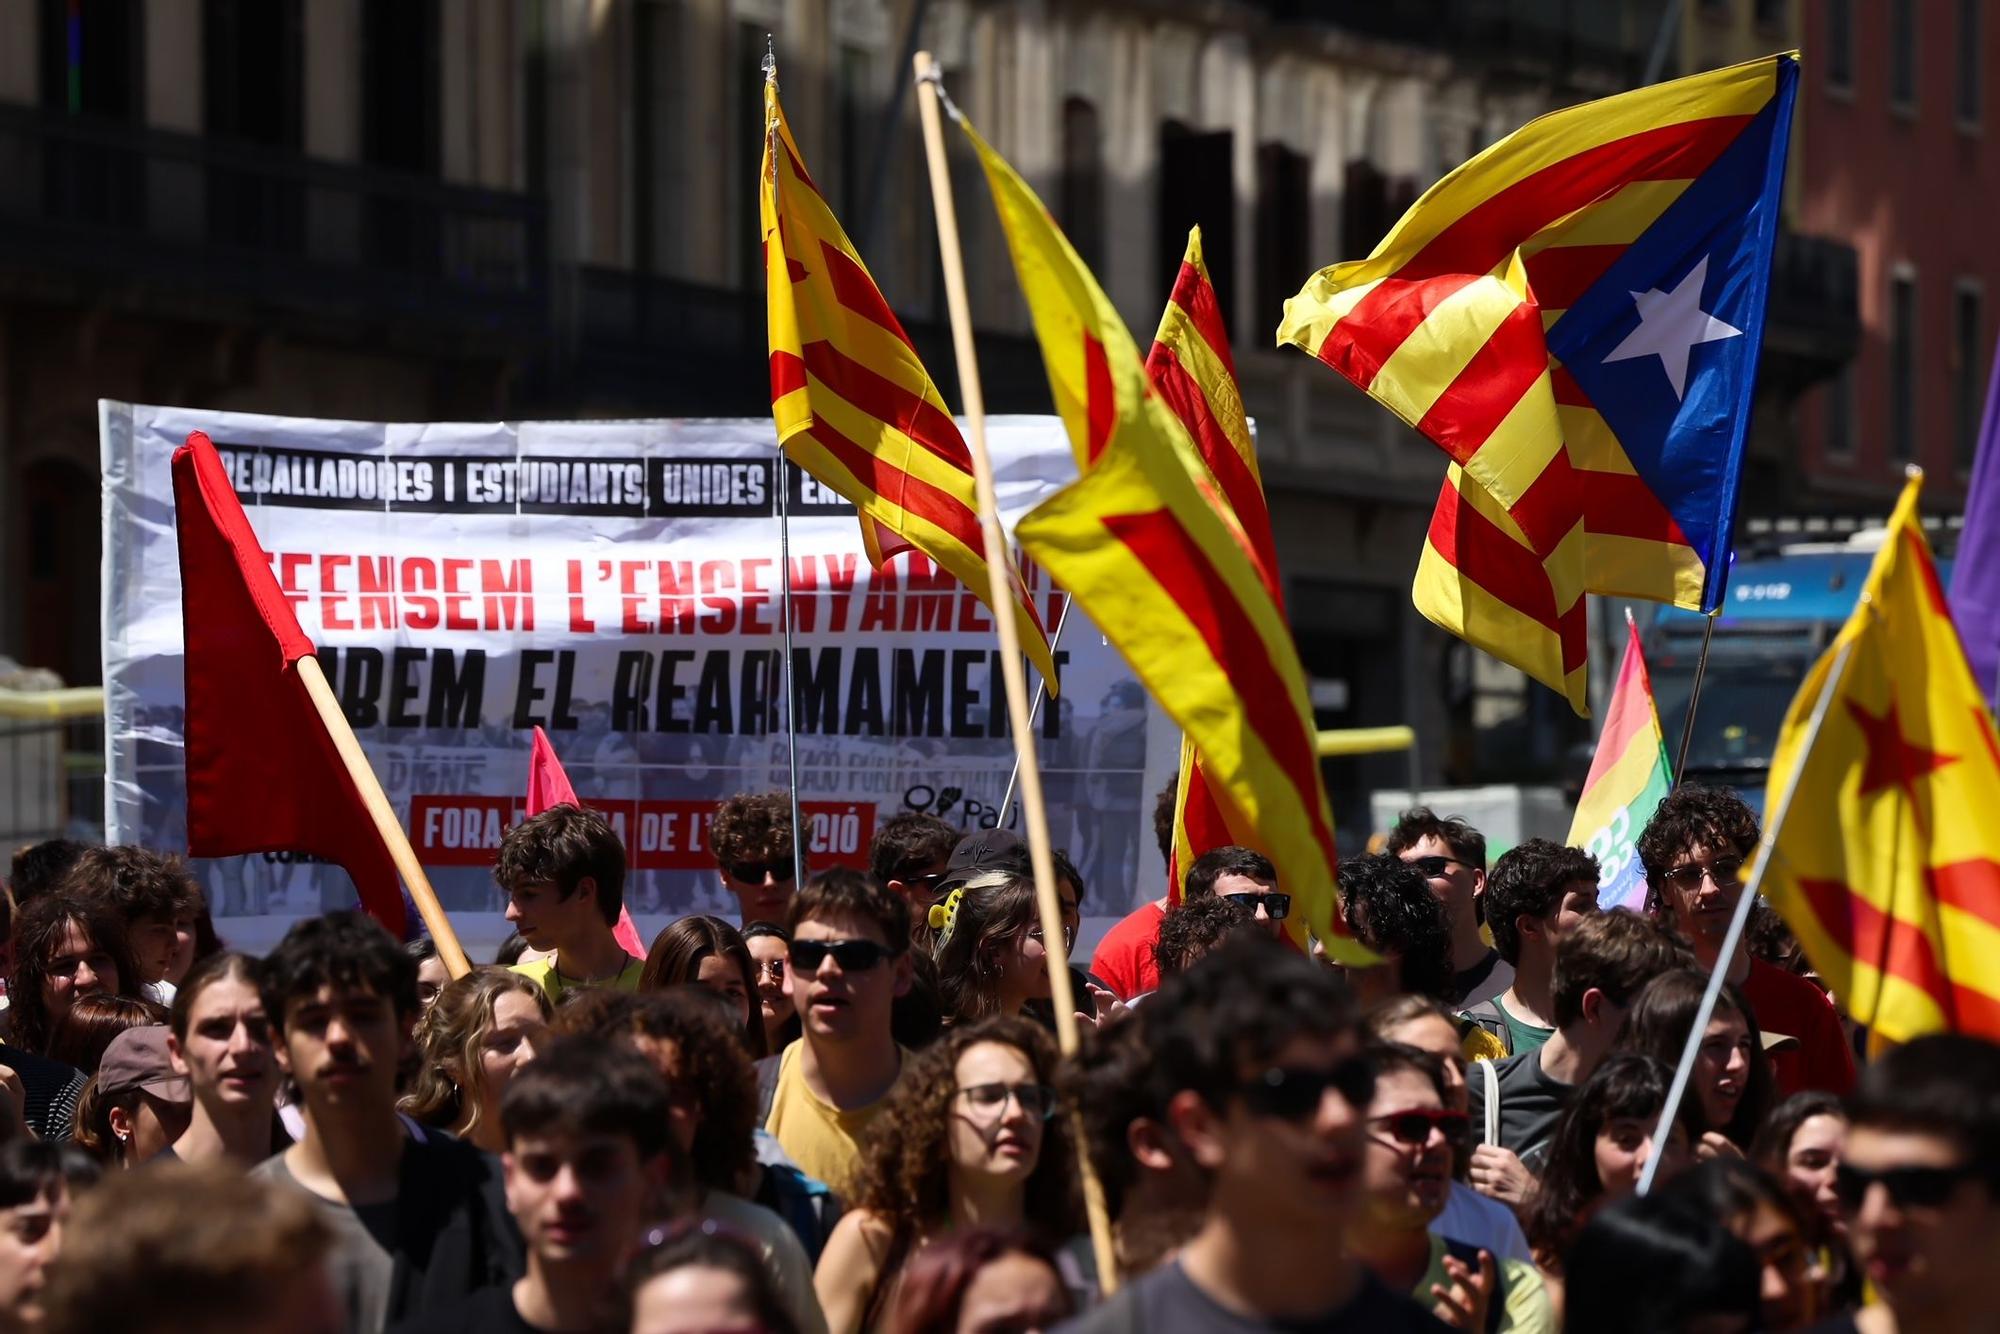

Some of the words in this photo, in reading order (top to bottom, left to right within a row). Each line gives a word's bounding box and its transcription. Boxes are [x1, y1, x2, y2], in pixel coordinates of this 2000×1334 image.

[444, 462, 455, 502] I
[467, 461, 650, 510] ESTUDIANTS,
[663, 463, 766, 505] UNIDES
[264, 552, 534, 632] FENSEM
[513, 649, 578, 730] EL
[424, 807, 502, 849] FORA
[640, 812, 676, 852] DE
